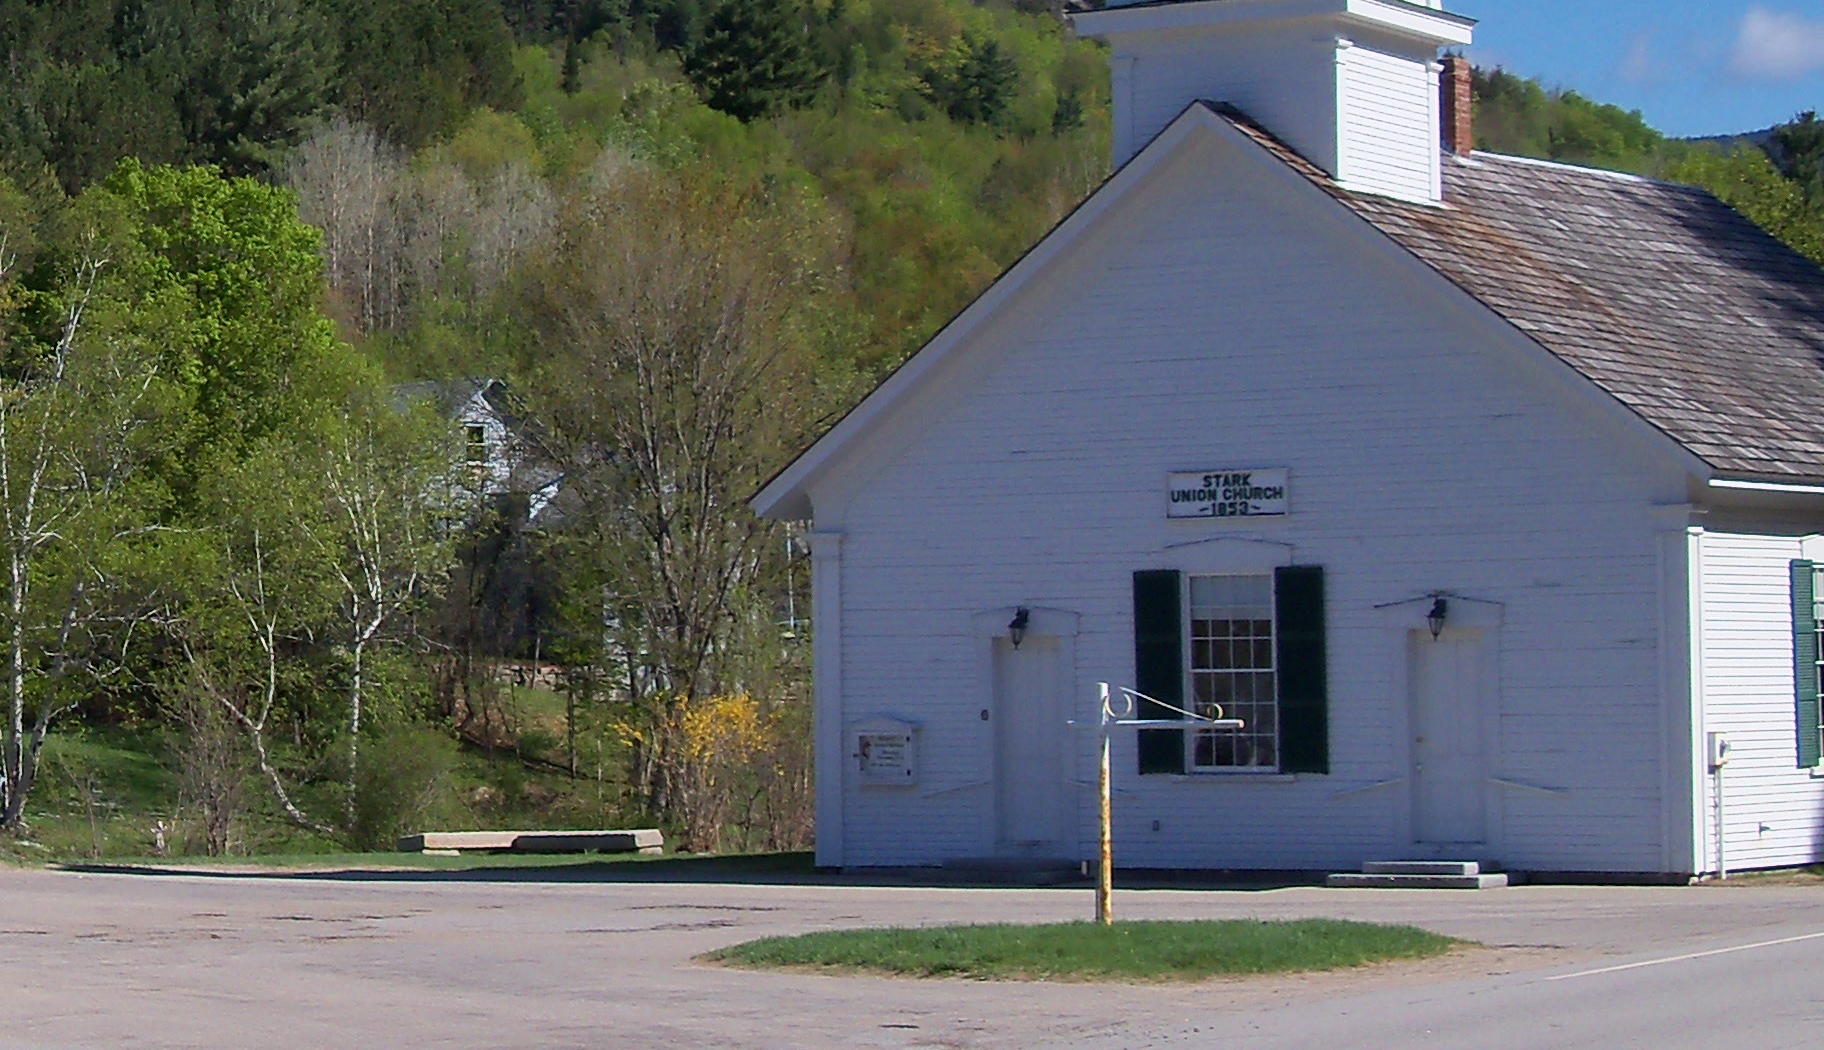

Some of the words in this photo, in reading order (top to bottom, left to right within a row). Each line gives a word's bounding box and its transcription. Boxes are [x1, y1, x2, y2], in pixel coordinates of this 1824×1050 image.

[1203, 473, 1252, 488] STARK
[1171, 488, 1217, 503] UNION
[1223, 486, 1283, 500] CHURCH
